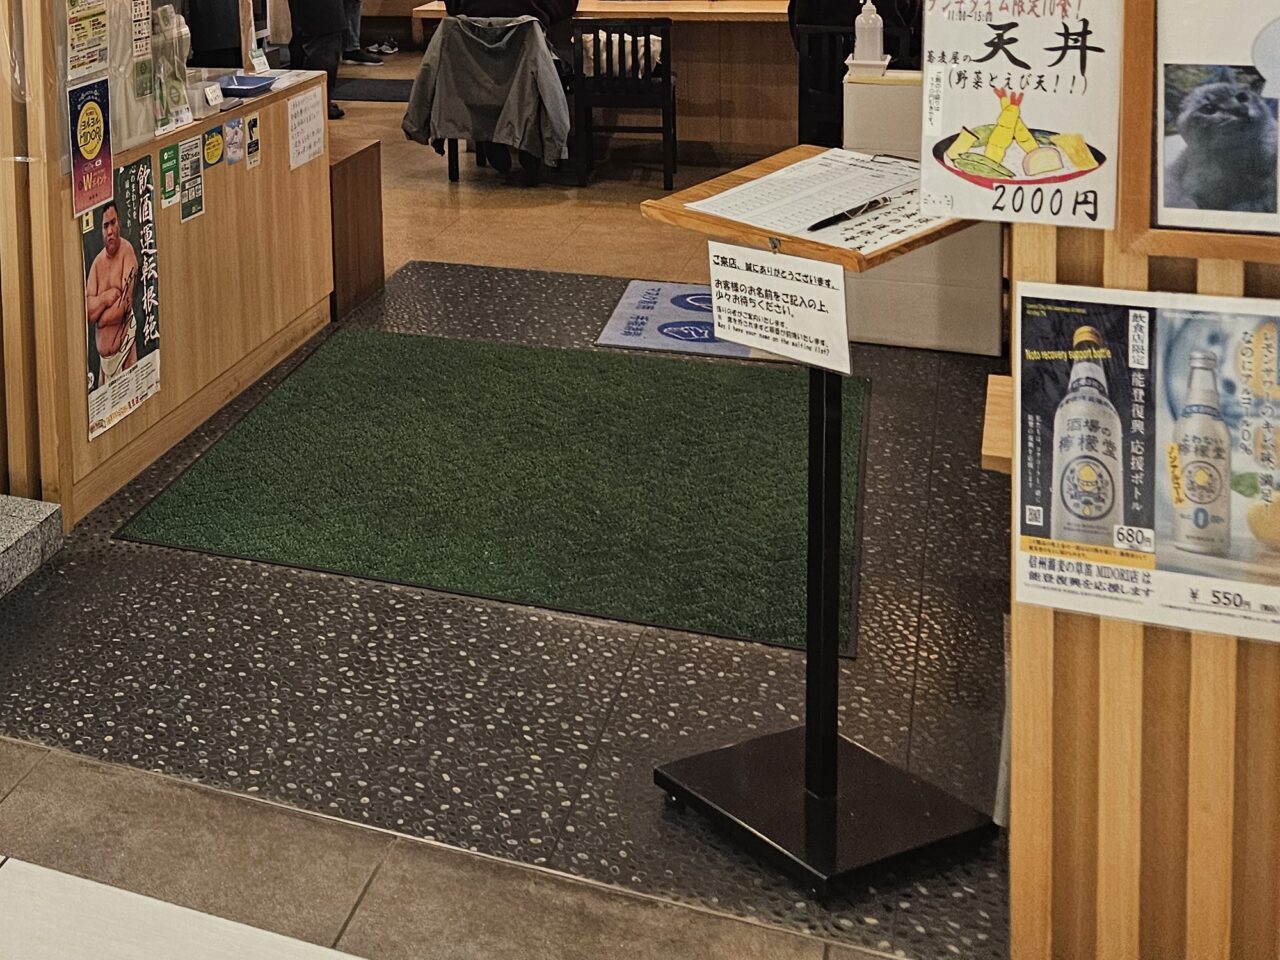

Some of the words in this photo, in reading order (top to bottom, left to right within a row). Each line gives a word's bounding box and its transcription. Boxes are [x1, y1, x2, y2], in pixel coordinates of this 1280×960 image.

[927, 50, 972, 65] 蕎麦屋の
[972, 17, 1106, 76] 天丼
[992, 184, 1098, 222] 2000円
[136, 163, 161, 348] 飲酒運転根絶
[715, 278, 829, 314] お客様のお名前をご記入の上、
[715, 291, 794, 318] 少々お待ちください。
[1025, 349, 1040, 360] Noto
[1041, 351, 1068, 361] recovery
[1068, 348, 1091, 360] support
[1092, 347, 1112, 358] bottle
